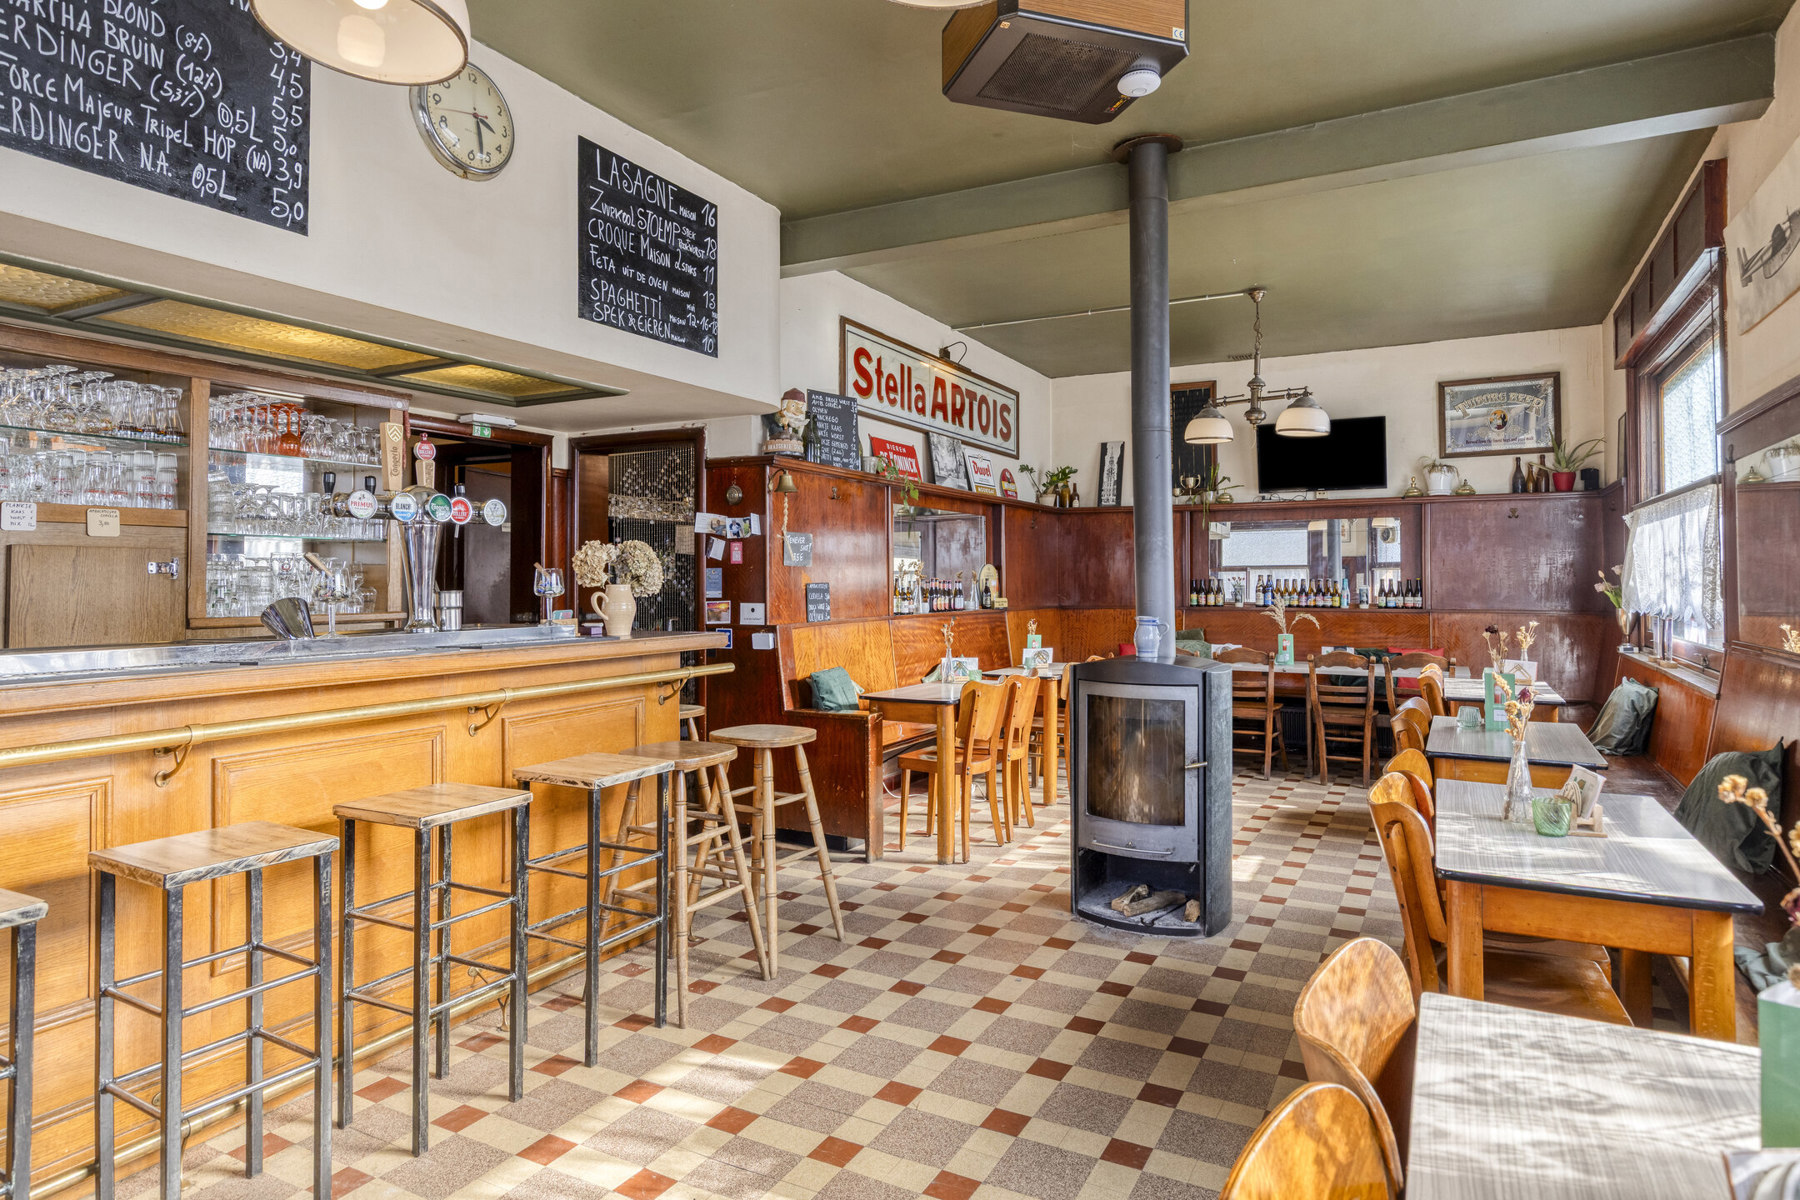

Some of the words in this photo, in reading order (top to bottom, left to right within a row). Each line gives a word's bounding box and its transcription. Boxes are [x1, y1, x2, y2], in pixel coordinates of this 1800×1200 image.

[104, 20, 164, 69] BRUIN
[176, 53, 223, 98] (12%)
[271, 96, 303, 128] 5,5
[270, 63, 303, 99] 4,5
[468, 72, 478, 85] 12
[432, 93, 442, 105] 9
[496, 105, 503, 117] 2
[218, 102, 263, 143] 0,5L
[272, 125, 297, 157] 5,0
[495, 144, 502, 154] 4
[501, 125, 508, 138] 3
[204, 125, 236, 163] HOP
[246, 145, 272, 178] (NA)
[275, 157, 303, 190] 3,9
[467, 149, 476, 161] 6
[140, 142, 173, 177] N.A.
[192, 163, 237, 200] 0,5L
[271, 187, 304, 227] 5,0
[596, 148, 678, 215] LASAGNE
[701, 203, 716, 227] 16
[588, 217, 636, 256] CROQUE
[640, 234, 671, 269] MAISON
[702, 265, 715, 285] 11
[637, 208, 681, 246] STOEMP
[704, 237, 718, 260] 18
[589, 243, 616, 274] FETA
[636, 271, 646, 284] DE
[648, 275, 669, 292] OVEN
[702, 290, 716, 309] 13
[590, 278, 662, 320] SPAGHETTI
[592, 302, 626, 327] SPEK
[637, 315, 671, 339] EIEREN
[702, 335, 714, 353] 10
[852, 346, 926, 417] Stella
[930, 375, 1012, 442] ARTOIS
[1454, 391, 1508, 420] TUBORG
[1508, 392, 1546, 417] BEER
[886, 443, 907, 453] BIEREN
[971, 460, 992, 478] Duvel
[350, 500, 374, 509] PRIMUS
